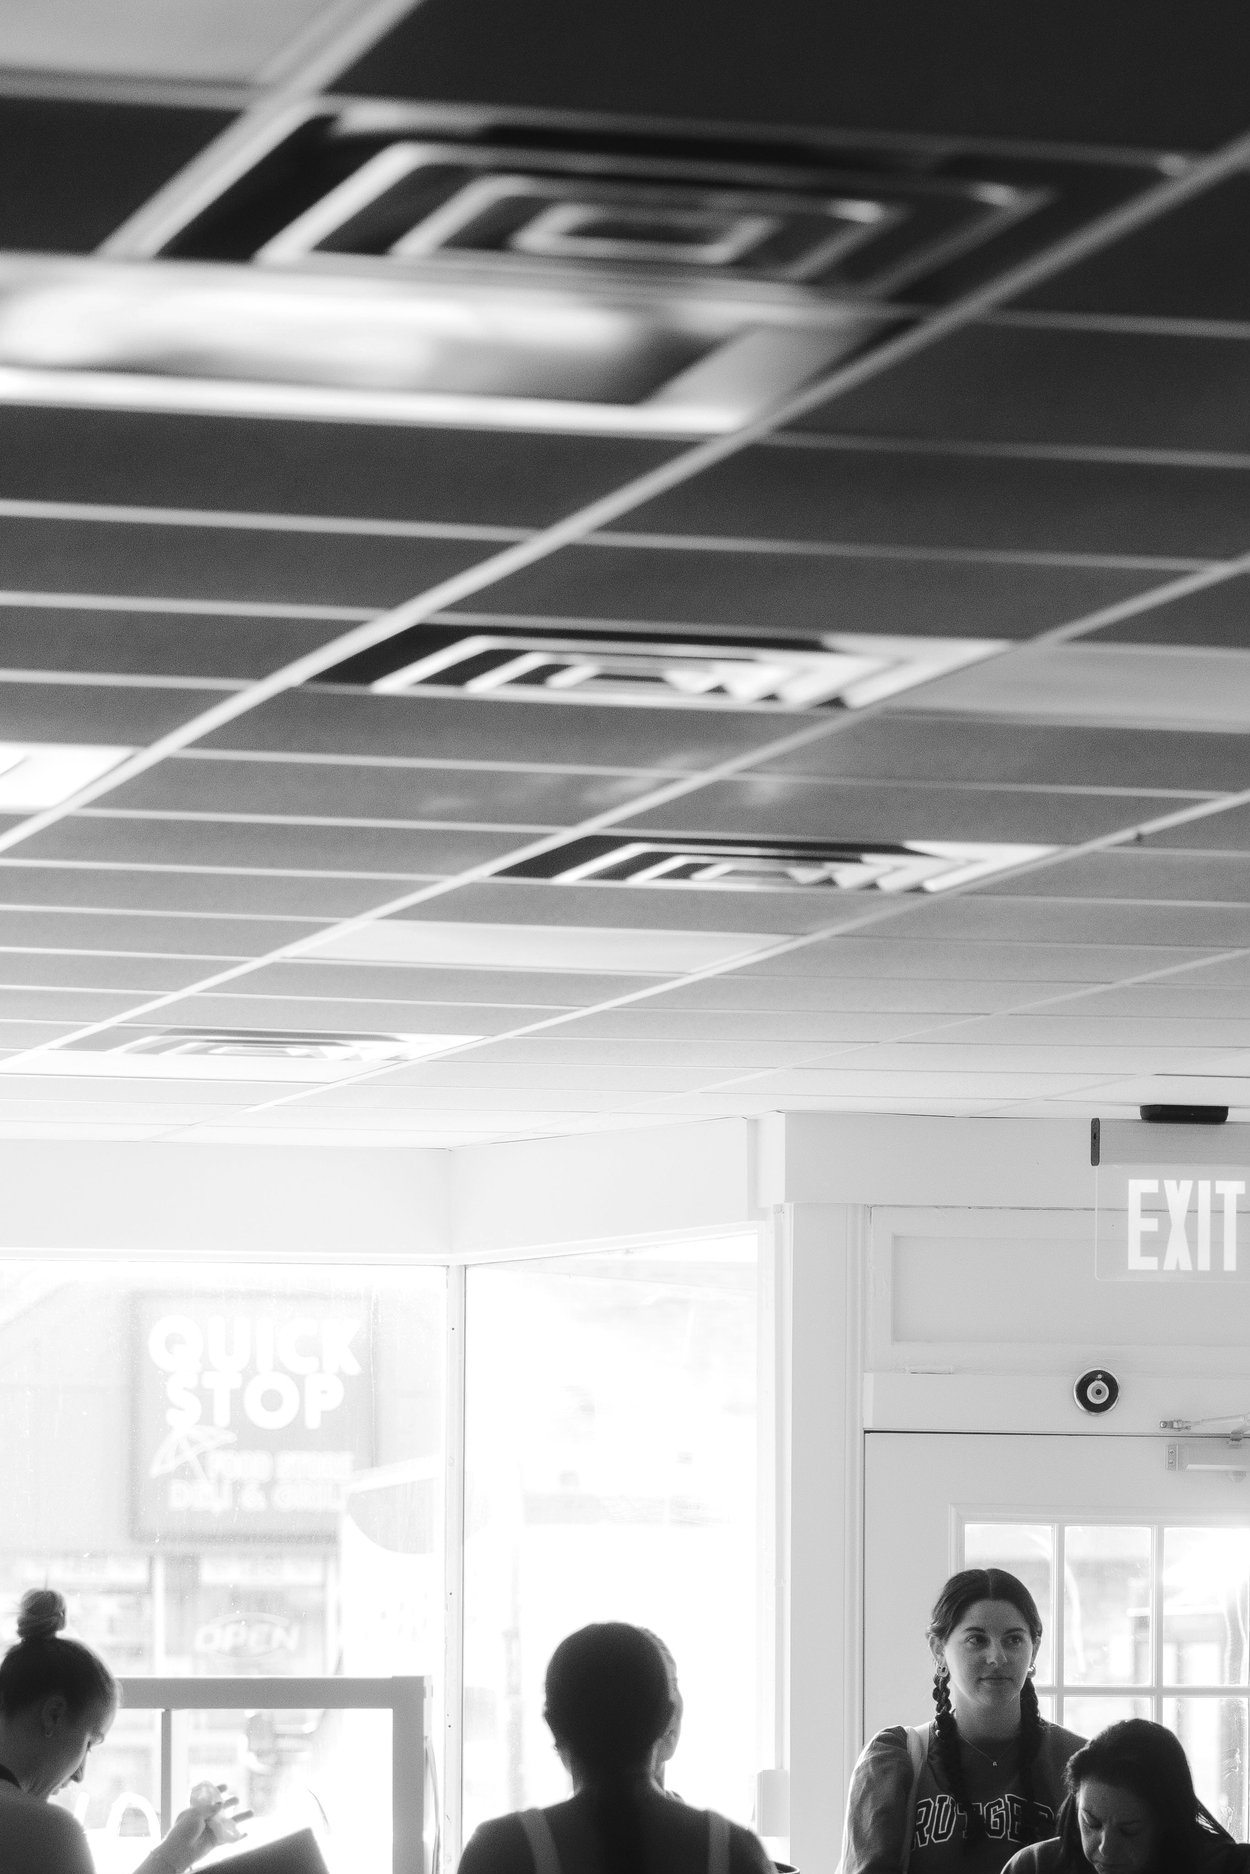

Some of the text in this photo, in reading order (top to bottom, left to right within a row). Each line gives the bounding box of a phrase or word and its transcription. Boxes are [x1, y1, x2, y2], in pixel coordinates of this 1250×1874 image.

[1128, 1179, 1246, 1271] EXIT
[148, 1315, 363, 1375] QUICK
[166, 1371, 345, 1430] STOP
